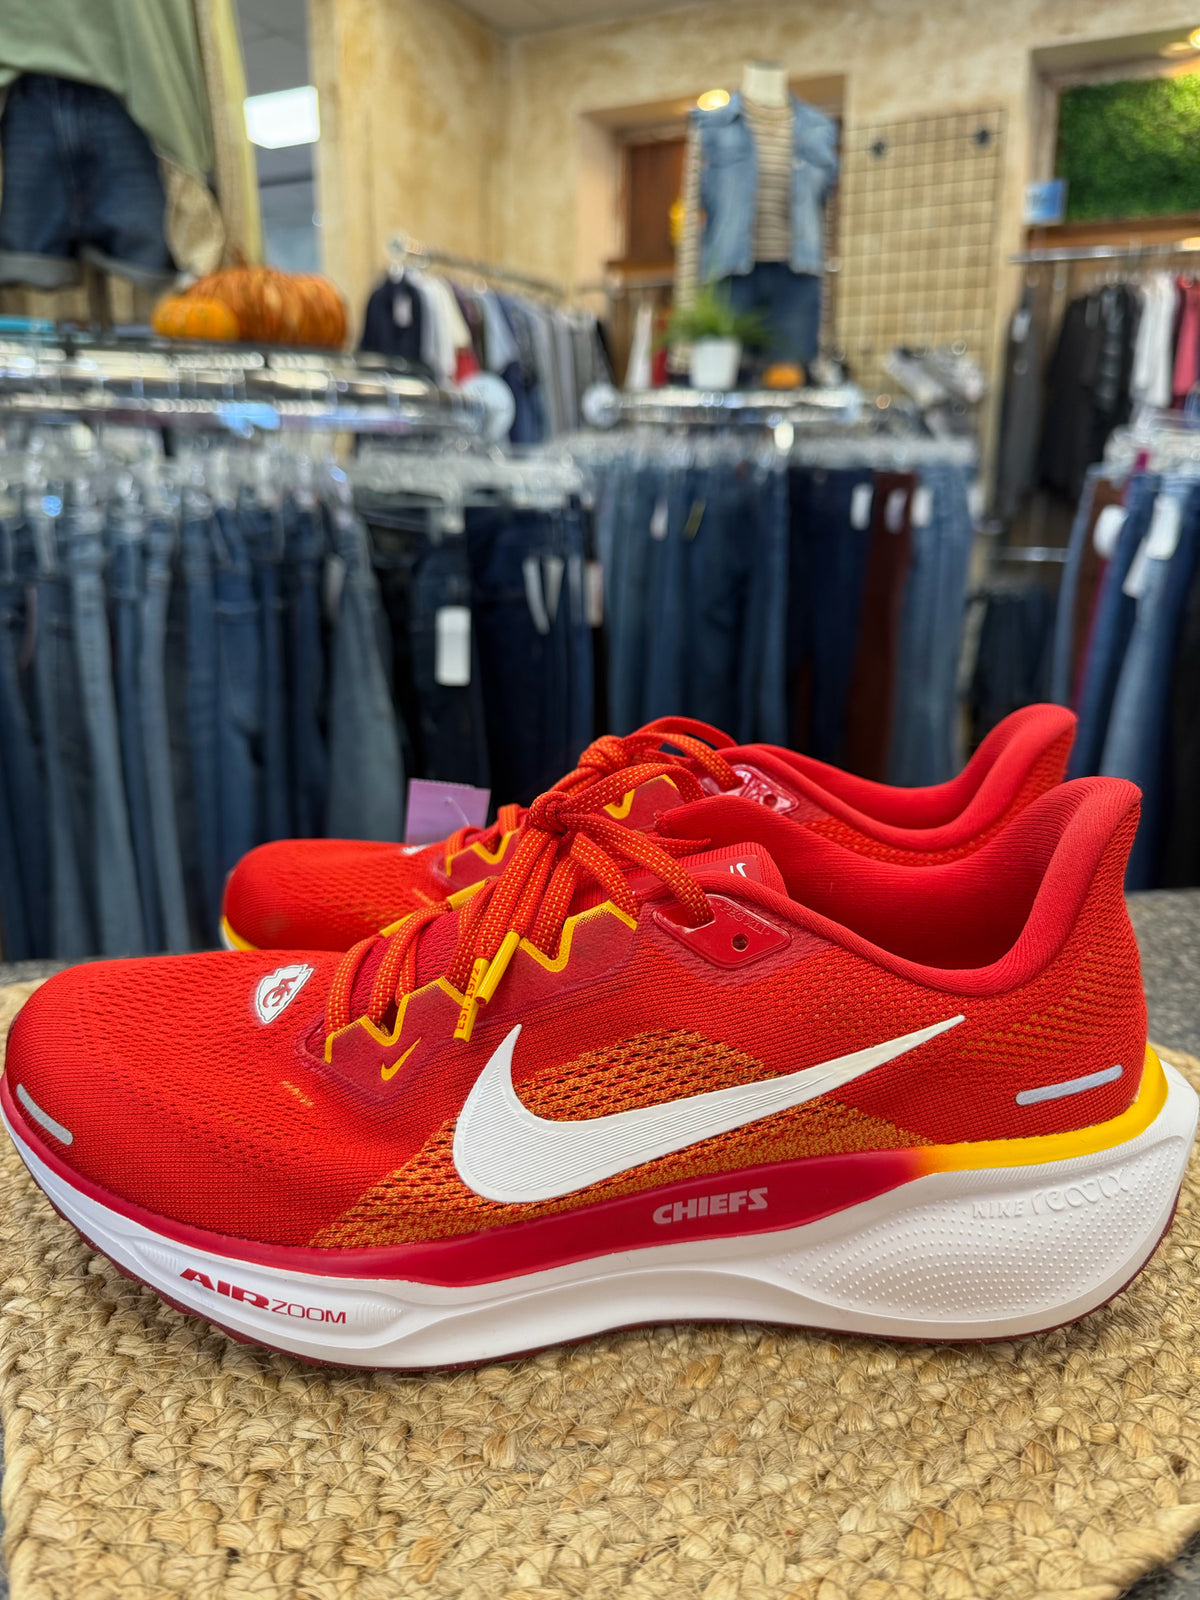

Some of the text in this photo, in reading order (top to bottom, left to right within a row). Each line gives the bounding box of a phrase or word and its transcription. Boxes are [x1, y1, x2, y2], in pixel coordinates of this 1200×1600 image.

[652, 1187, 769, 1225] CHIEFS
[972, 1200, 1024, 1219] NIKE
[180, 1267, 347, 1324] AIR ZOOM
